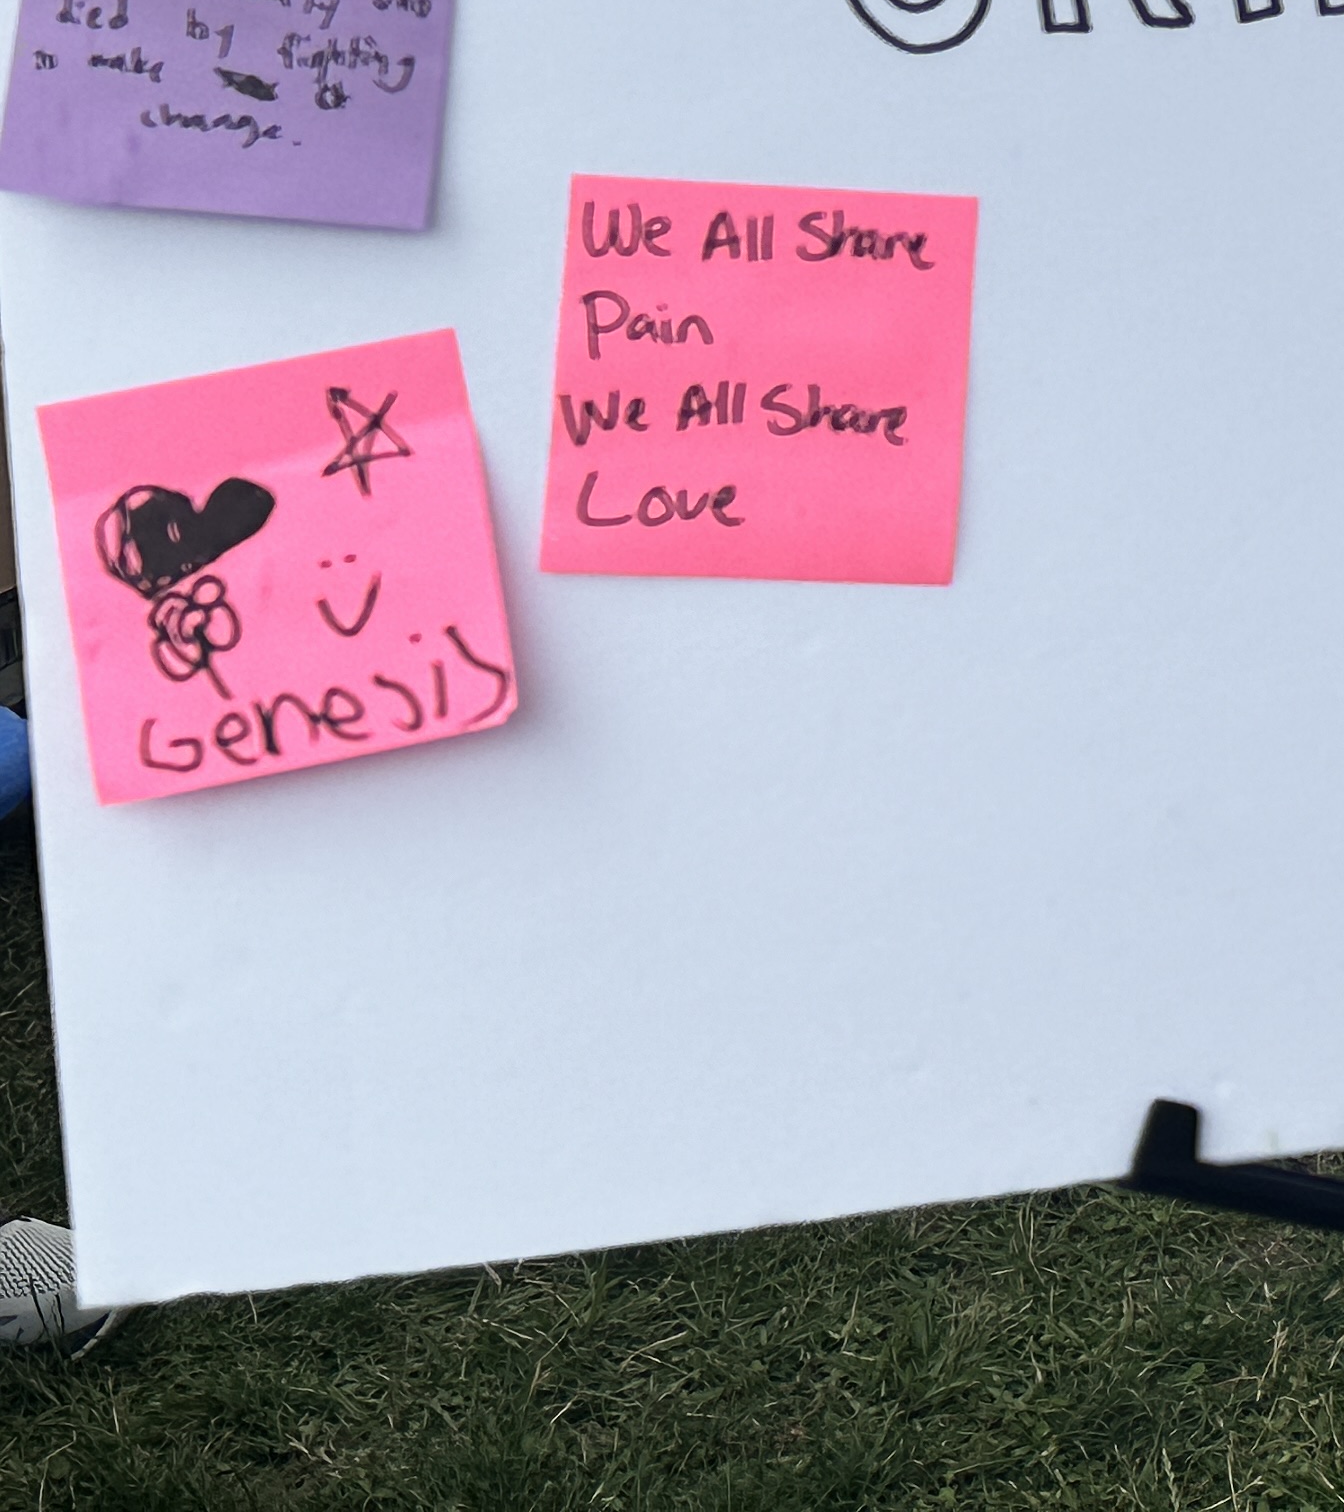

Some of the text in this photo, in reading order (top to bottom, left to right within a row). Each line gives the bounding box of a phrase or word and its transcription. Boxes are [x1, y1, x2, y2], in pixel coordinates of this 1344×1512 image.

[186, 8, 234, 58] by
[581, 200, 935, 271] We All Share
[579, 290, 714, 360] Pain
[557, 380, 908, 447] We All Share
[576, 470, 746, 527] Love
[140, 625, 510, 772] Genesis
